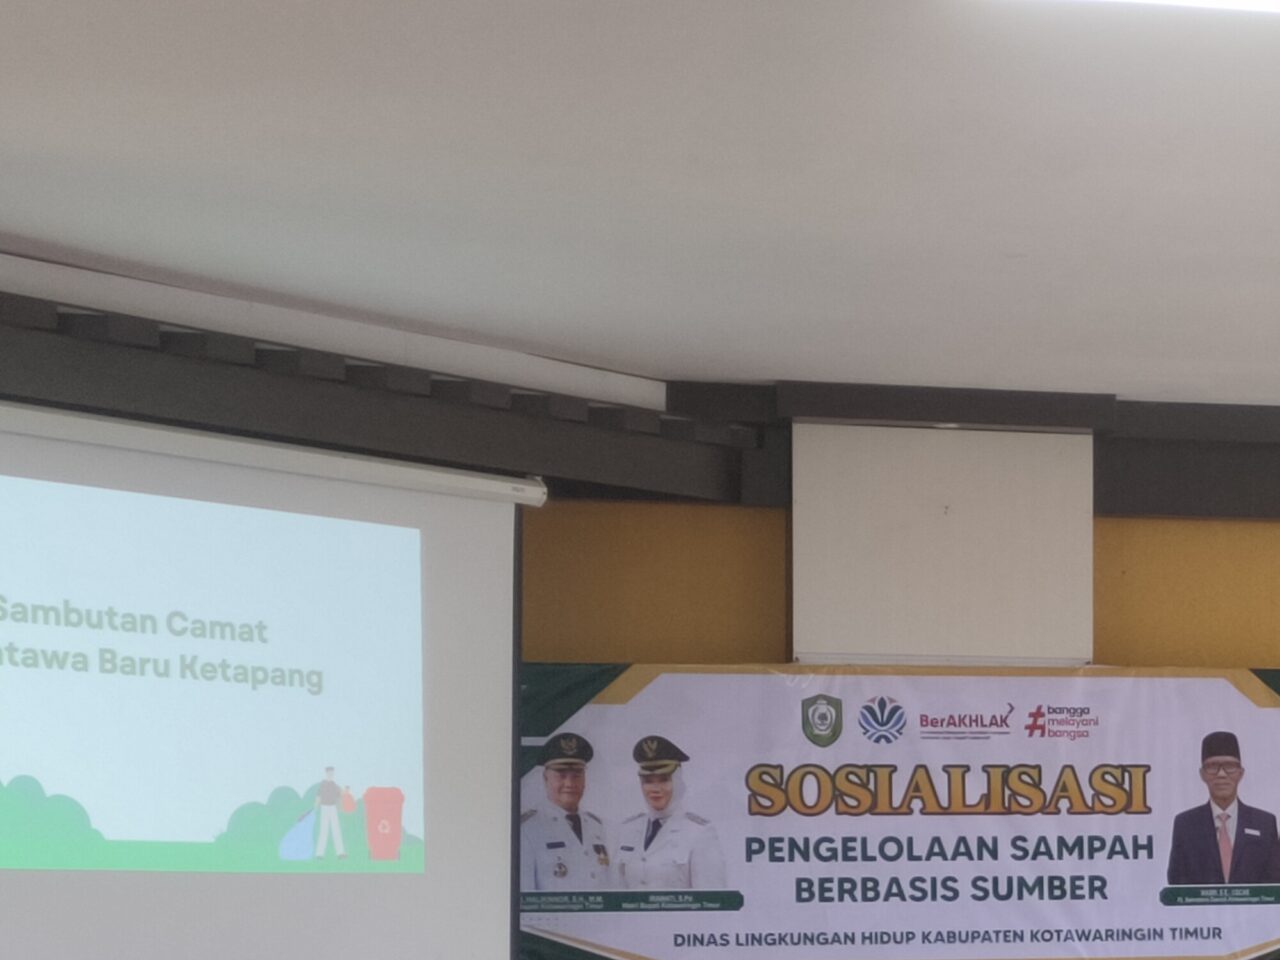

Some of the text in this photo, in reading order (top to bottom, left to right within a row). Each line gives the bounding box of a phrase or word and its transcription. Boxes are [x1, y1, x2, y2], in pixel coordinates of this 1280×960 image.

[166, 610, 269, 644] Camat
[0, 640, 324, 696] tawa Baru Ketapang
[919, 713, 1010, 729] BerAKHLAK
[1047, 705, 1091, 718] bangga
[1047, 716, 1099, 729] melayani
[1047, 728, 1090, 741] bangsa
[745, 763, 1152, 817] SOSIALISASI
[745, 834, 1154, 863] PENGELOLAAN SAMPAH
[795, 875, 1108, 904] BERBASIS SUMBER
[673, 926, 1223, 948] DINAS LINGKUNGAN HIDUP KABUPATEN KOTAWARINGIN TIMUR
